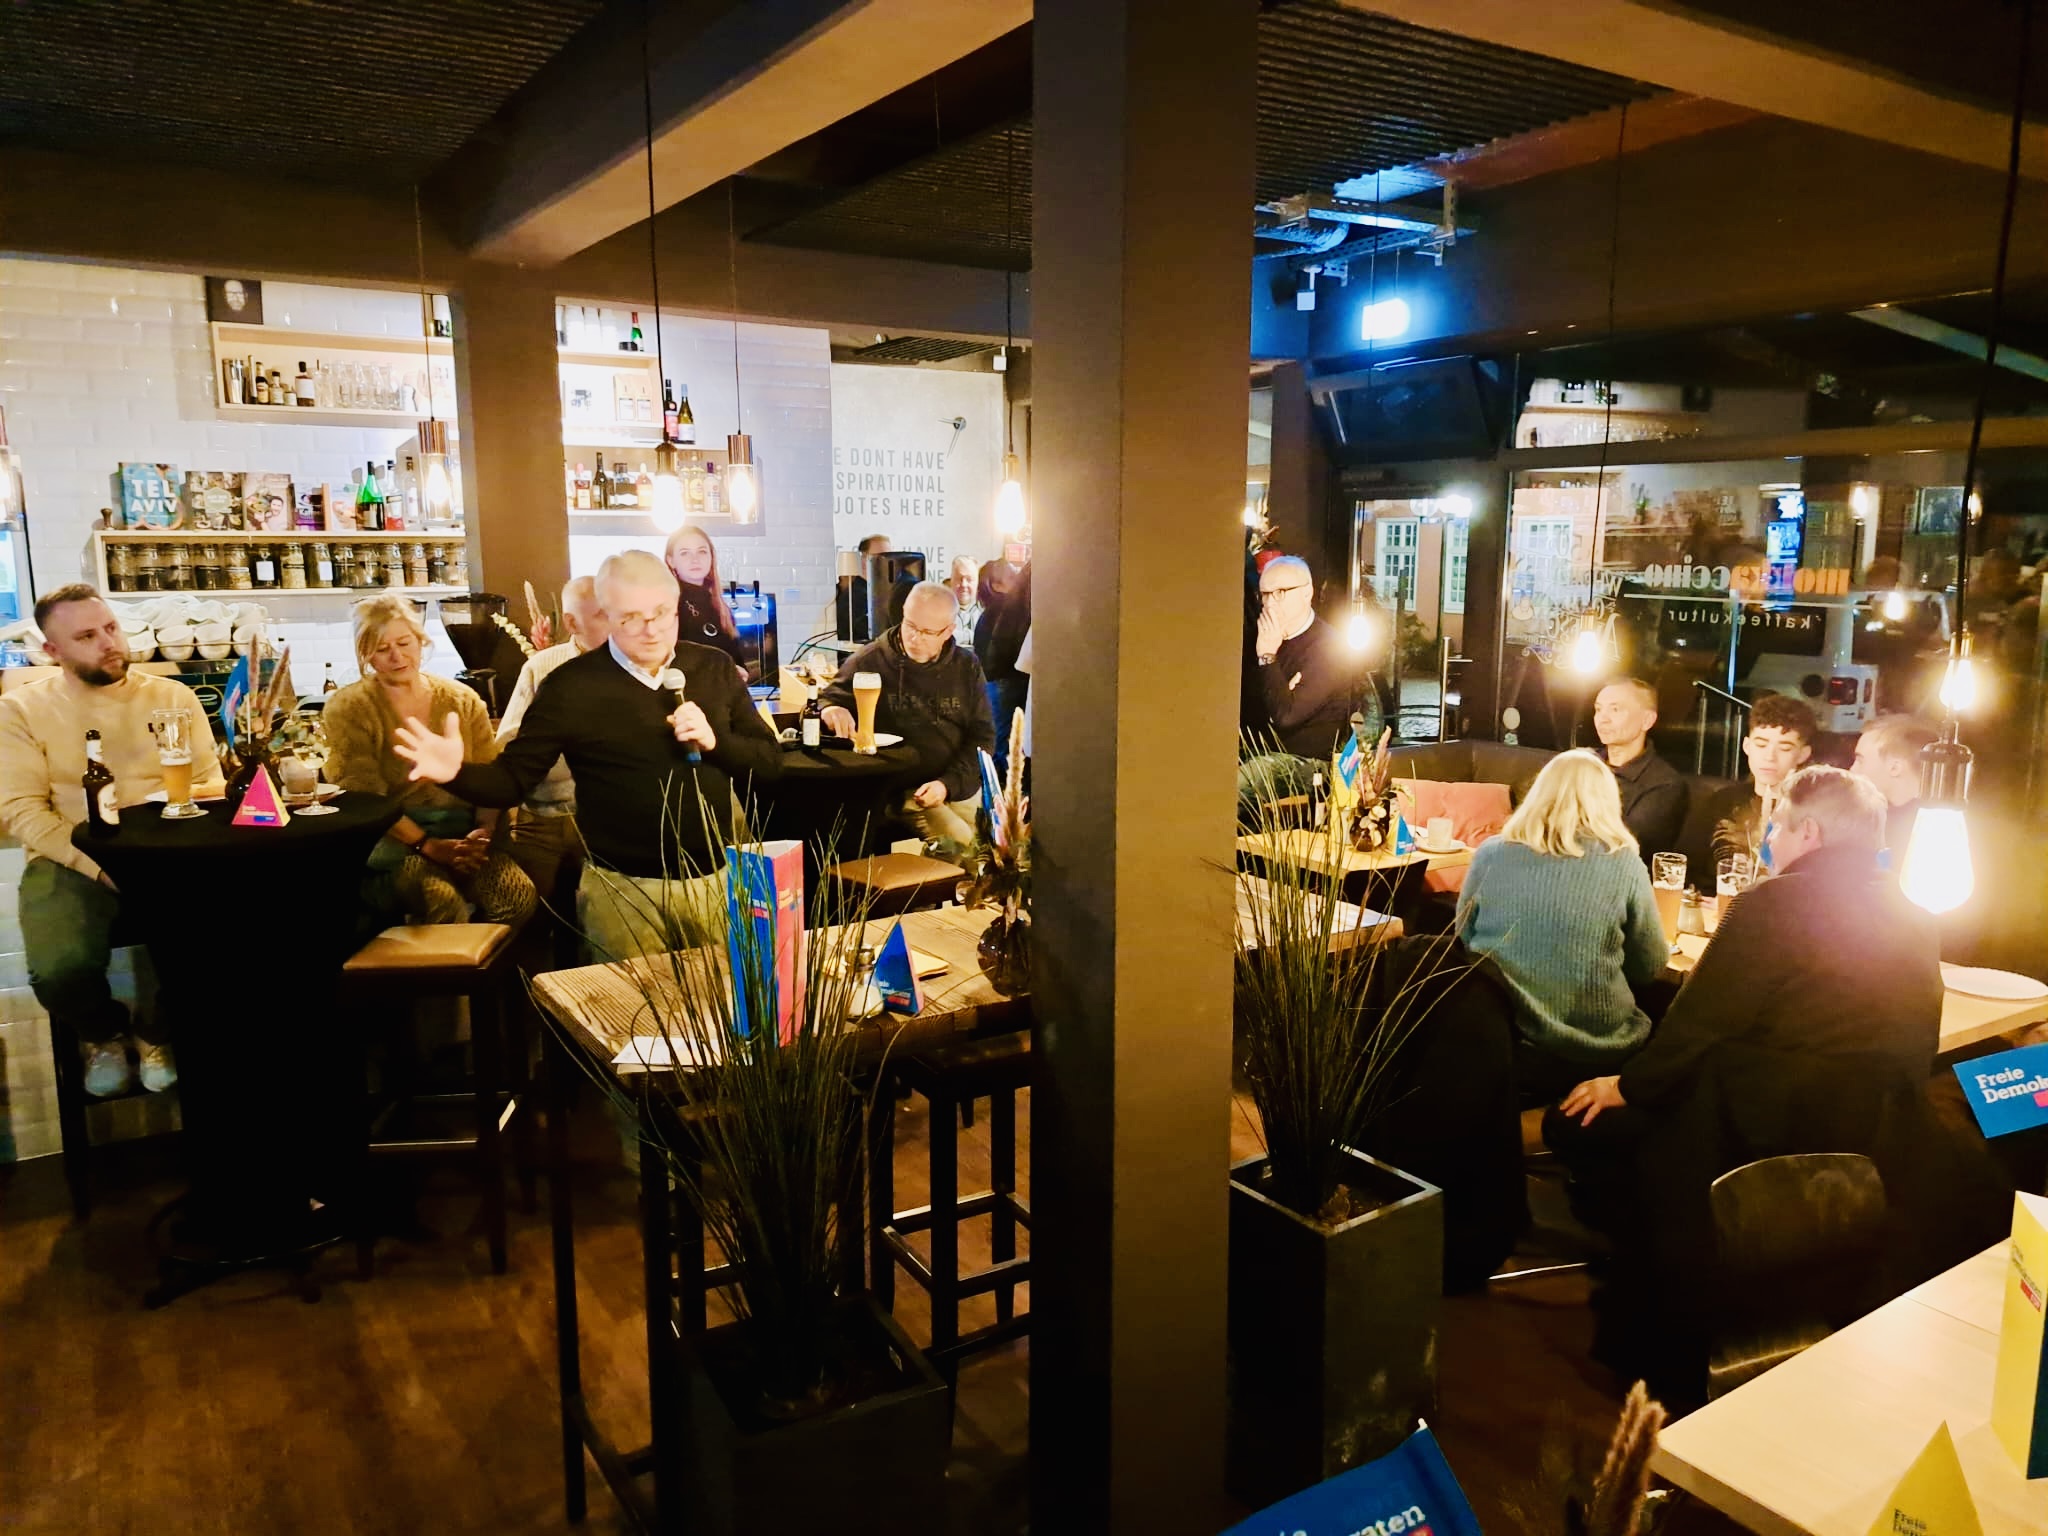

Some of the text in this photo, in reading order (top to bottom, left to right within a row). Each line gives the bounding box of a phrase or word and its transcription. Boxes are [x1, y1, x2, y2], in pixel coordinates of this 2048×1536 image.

[850, 448, 896, 468] DONT
[903, 451, 945, 470] HAVE
[131, 479, 176, 498] TEL
[836, 472, 945, 494] SPIRATIONAL
[130, 499, 178, 513] AVIV
[900, 499, 945, 517] HERE
[1974, 1067, 2025, 1090] Freie
